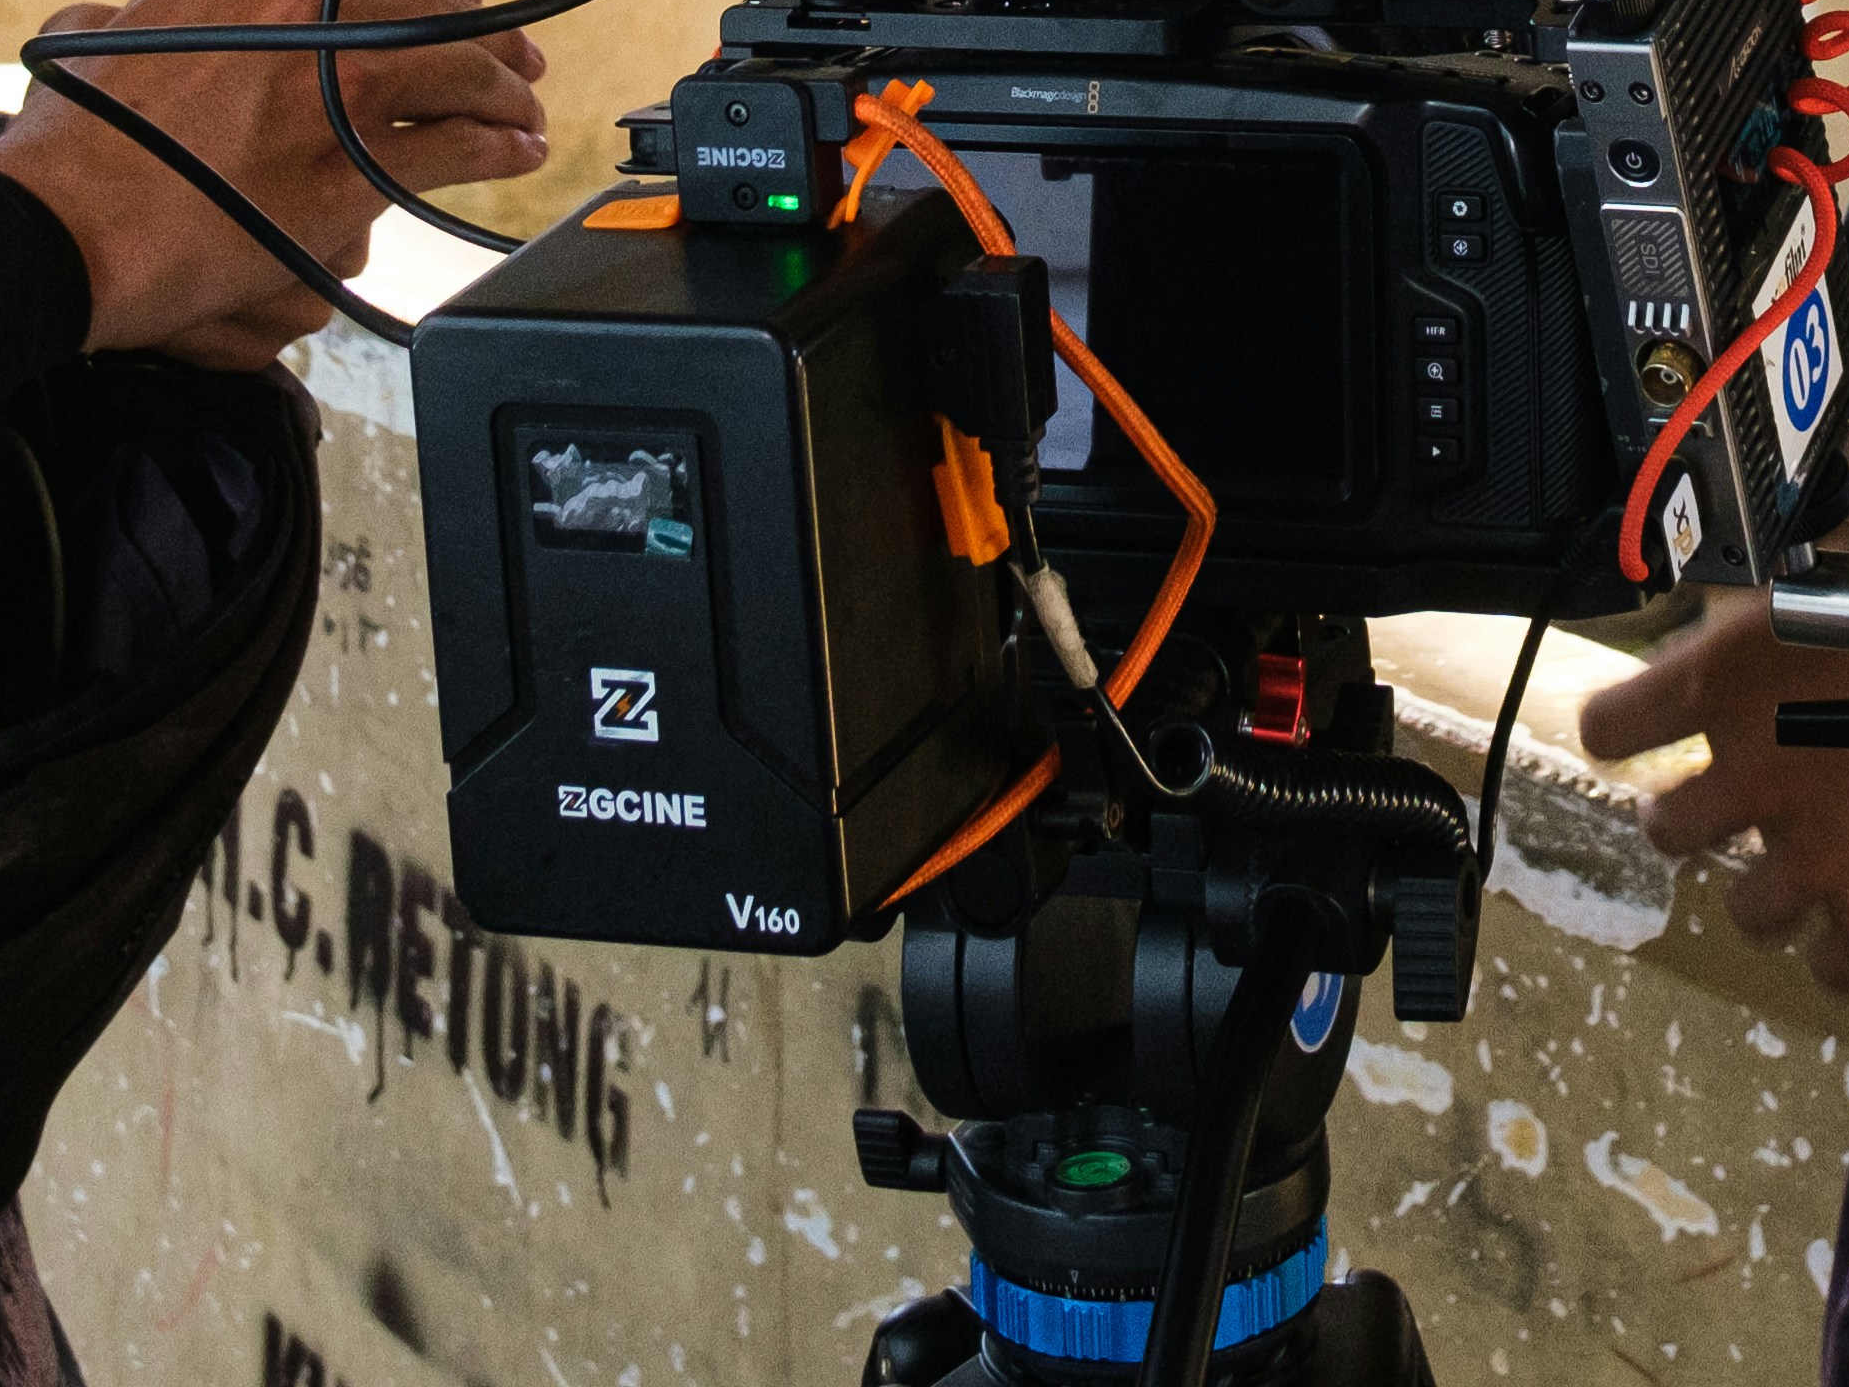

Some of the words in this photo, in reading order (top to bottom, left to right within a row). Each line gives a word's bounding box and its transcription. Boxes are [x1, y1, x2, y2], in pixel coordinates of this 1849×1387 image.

[696, 146, 786, 169] ZGCINE
[1640, 242, 1660, 275] SDI
[1790, 311, 1824, 411] 03
[558, 784, 707, 828] ZGCINE
[724, 893, 801, 935] V160
